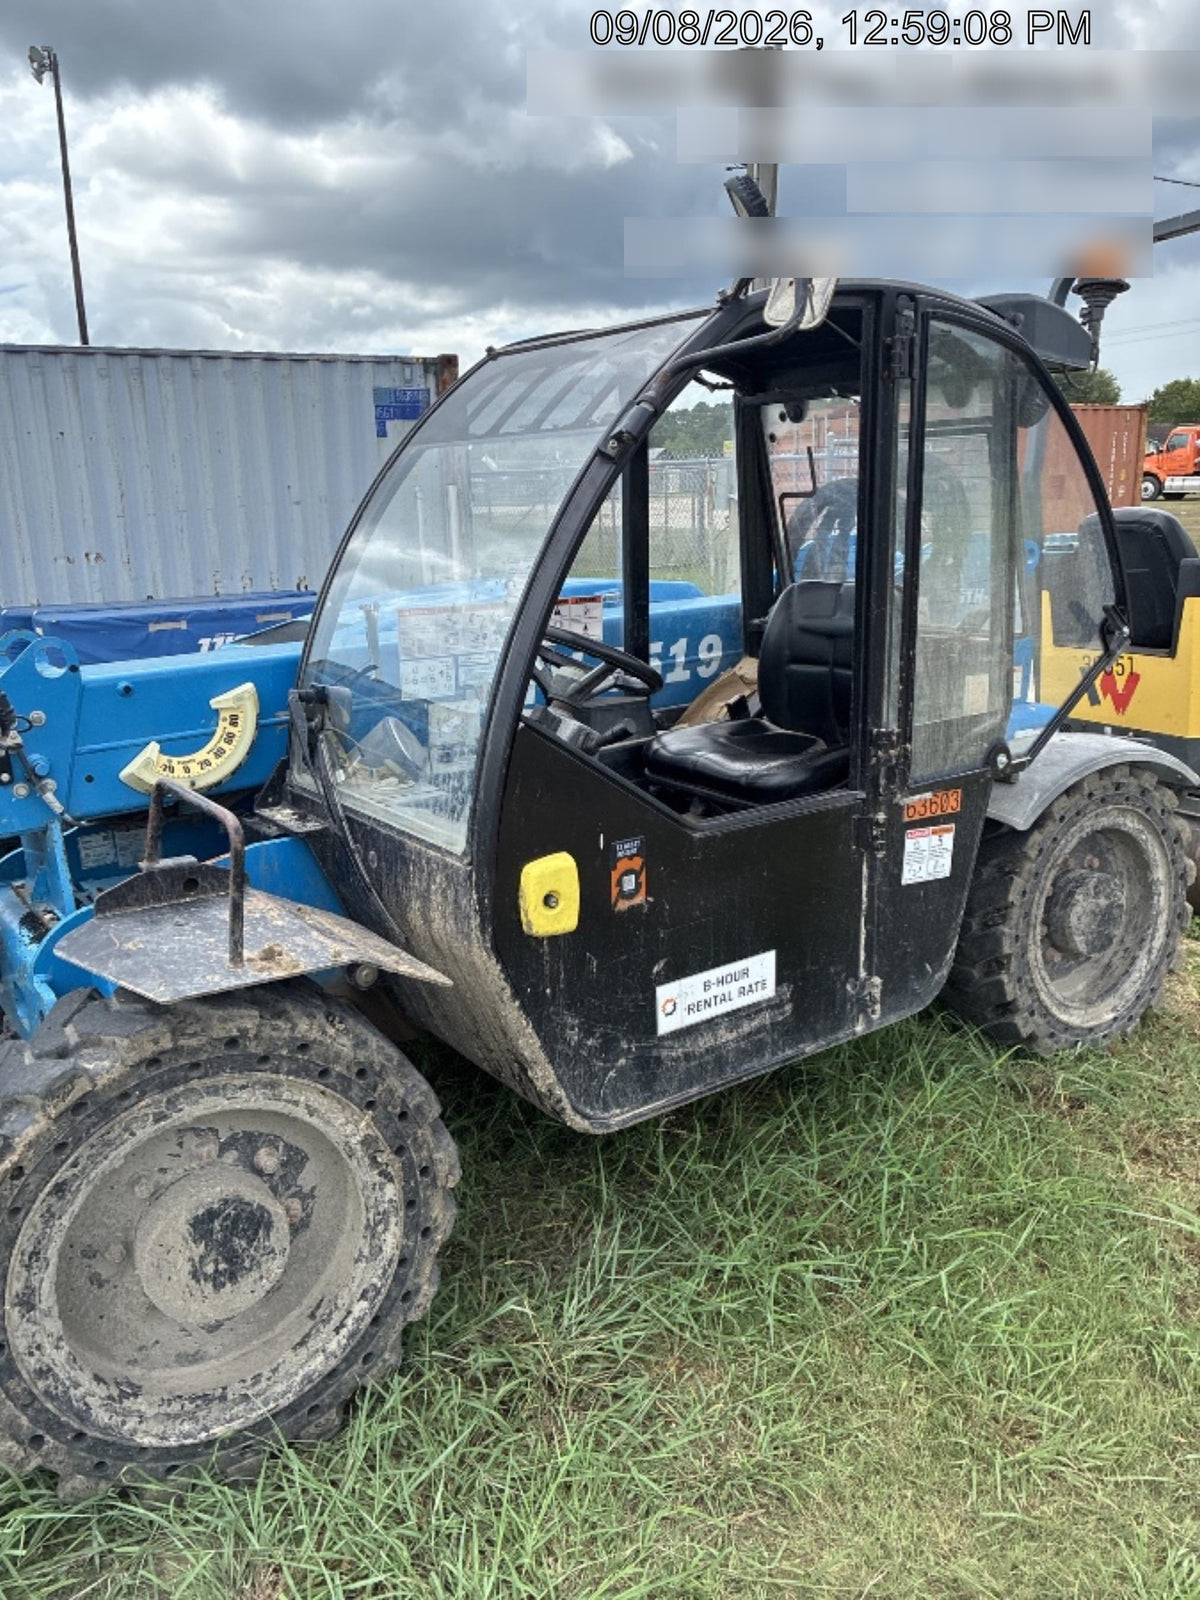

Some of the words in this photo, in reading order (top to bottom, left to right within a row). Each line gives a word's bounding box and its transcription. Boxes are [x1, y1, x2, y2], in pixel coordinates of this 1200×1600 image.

[1082, 655, 1134, 676] 351
[905, 791, 960, 819] 63603
[686, 990, 734, 1016] RENTAL
[738, 979, 768, 999] RATE
